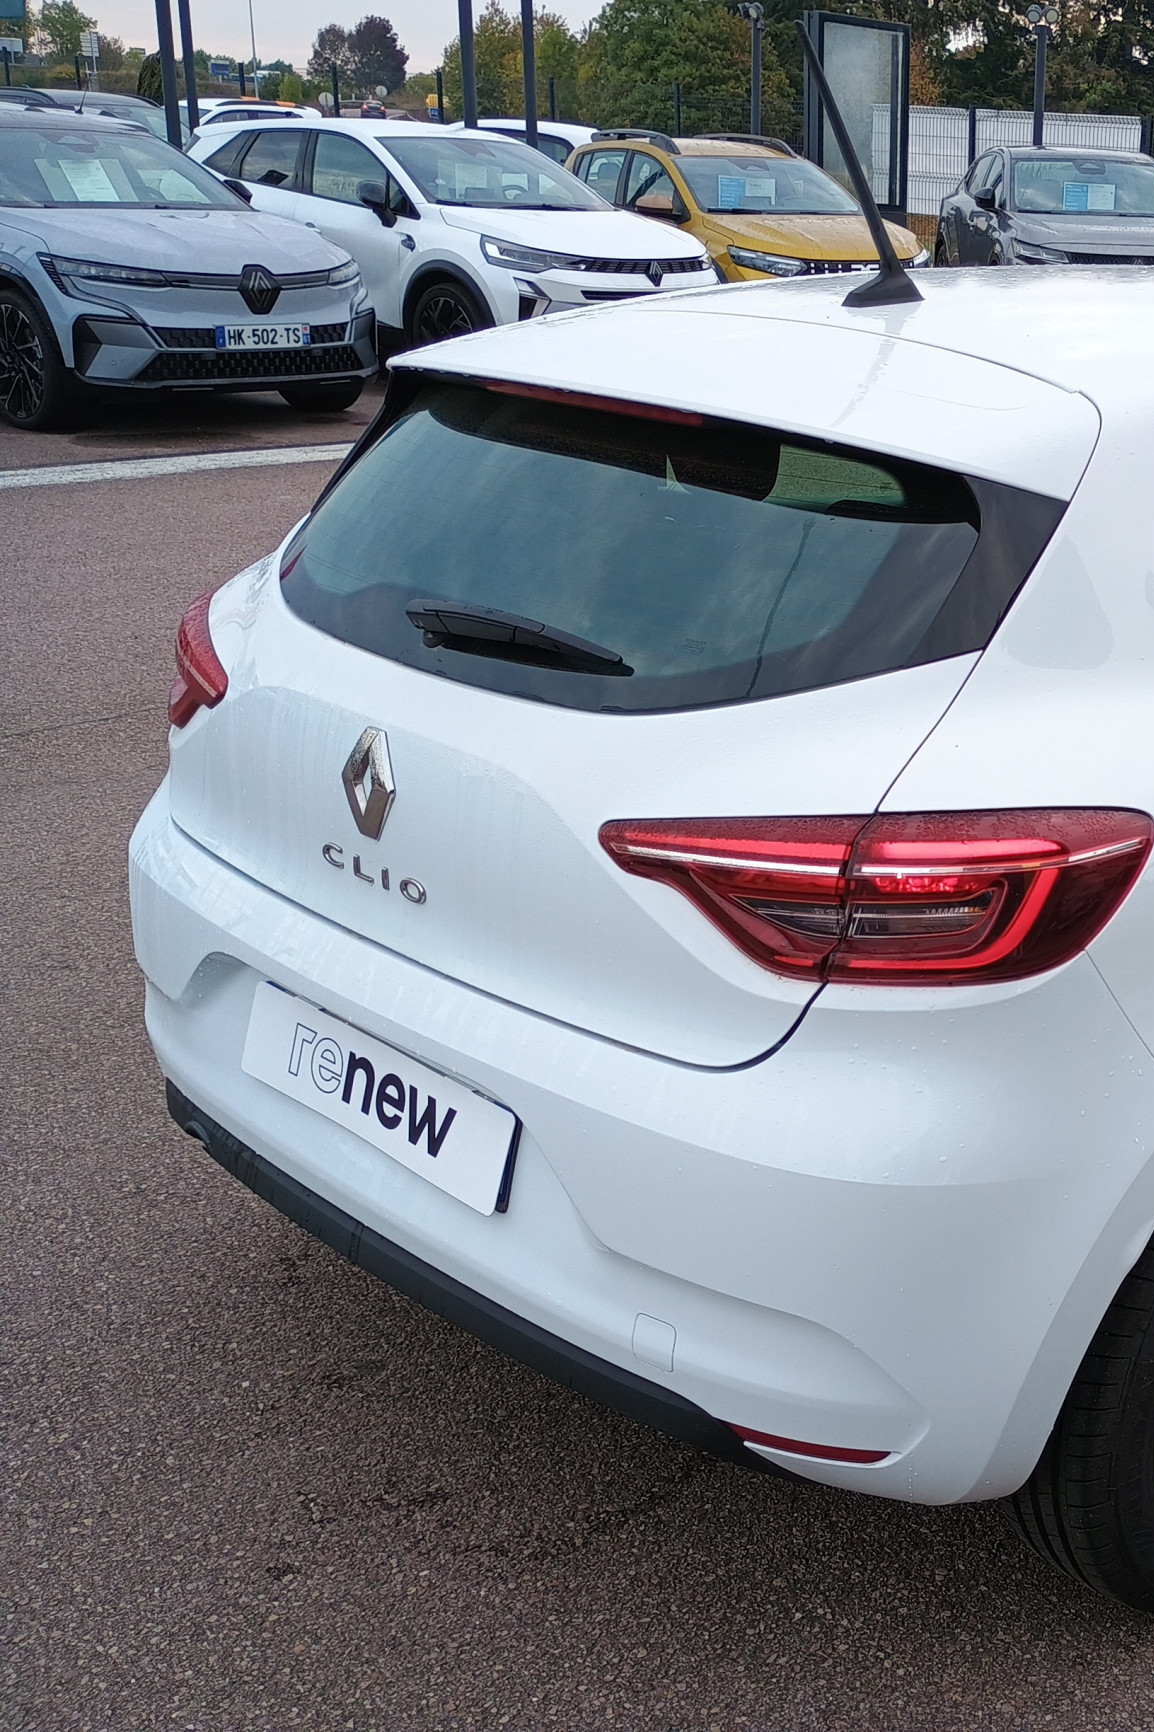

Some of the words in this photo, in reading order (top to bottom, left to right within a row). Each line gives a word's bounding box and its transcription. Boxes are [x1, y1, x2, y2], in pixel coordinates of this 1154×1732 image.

[227, 327, 301, 346] HK-502-TS
[322, 842, 427, 905] CLIO
[288, 1022, 458, 1158] renew
